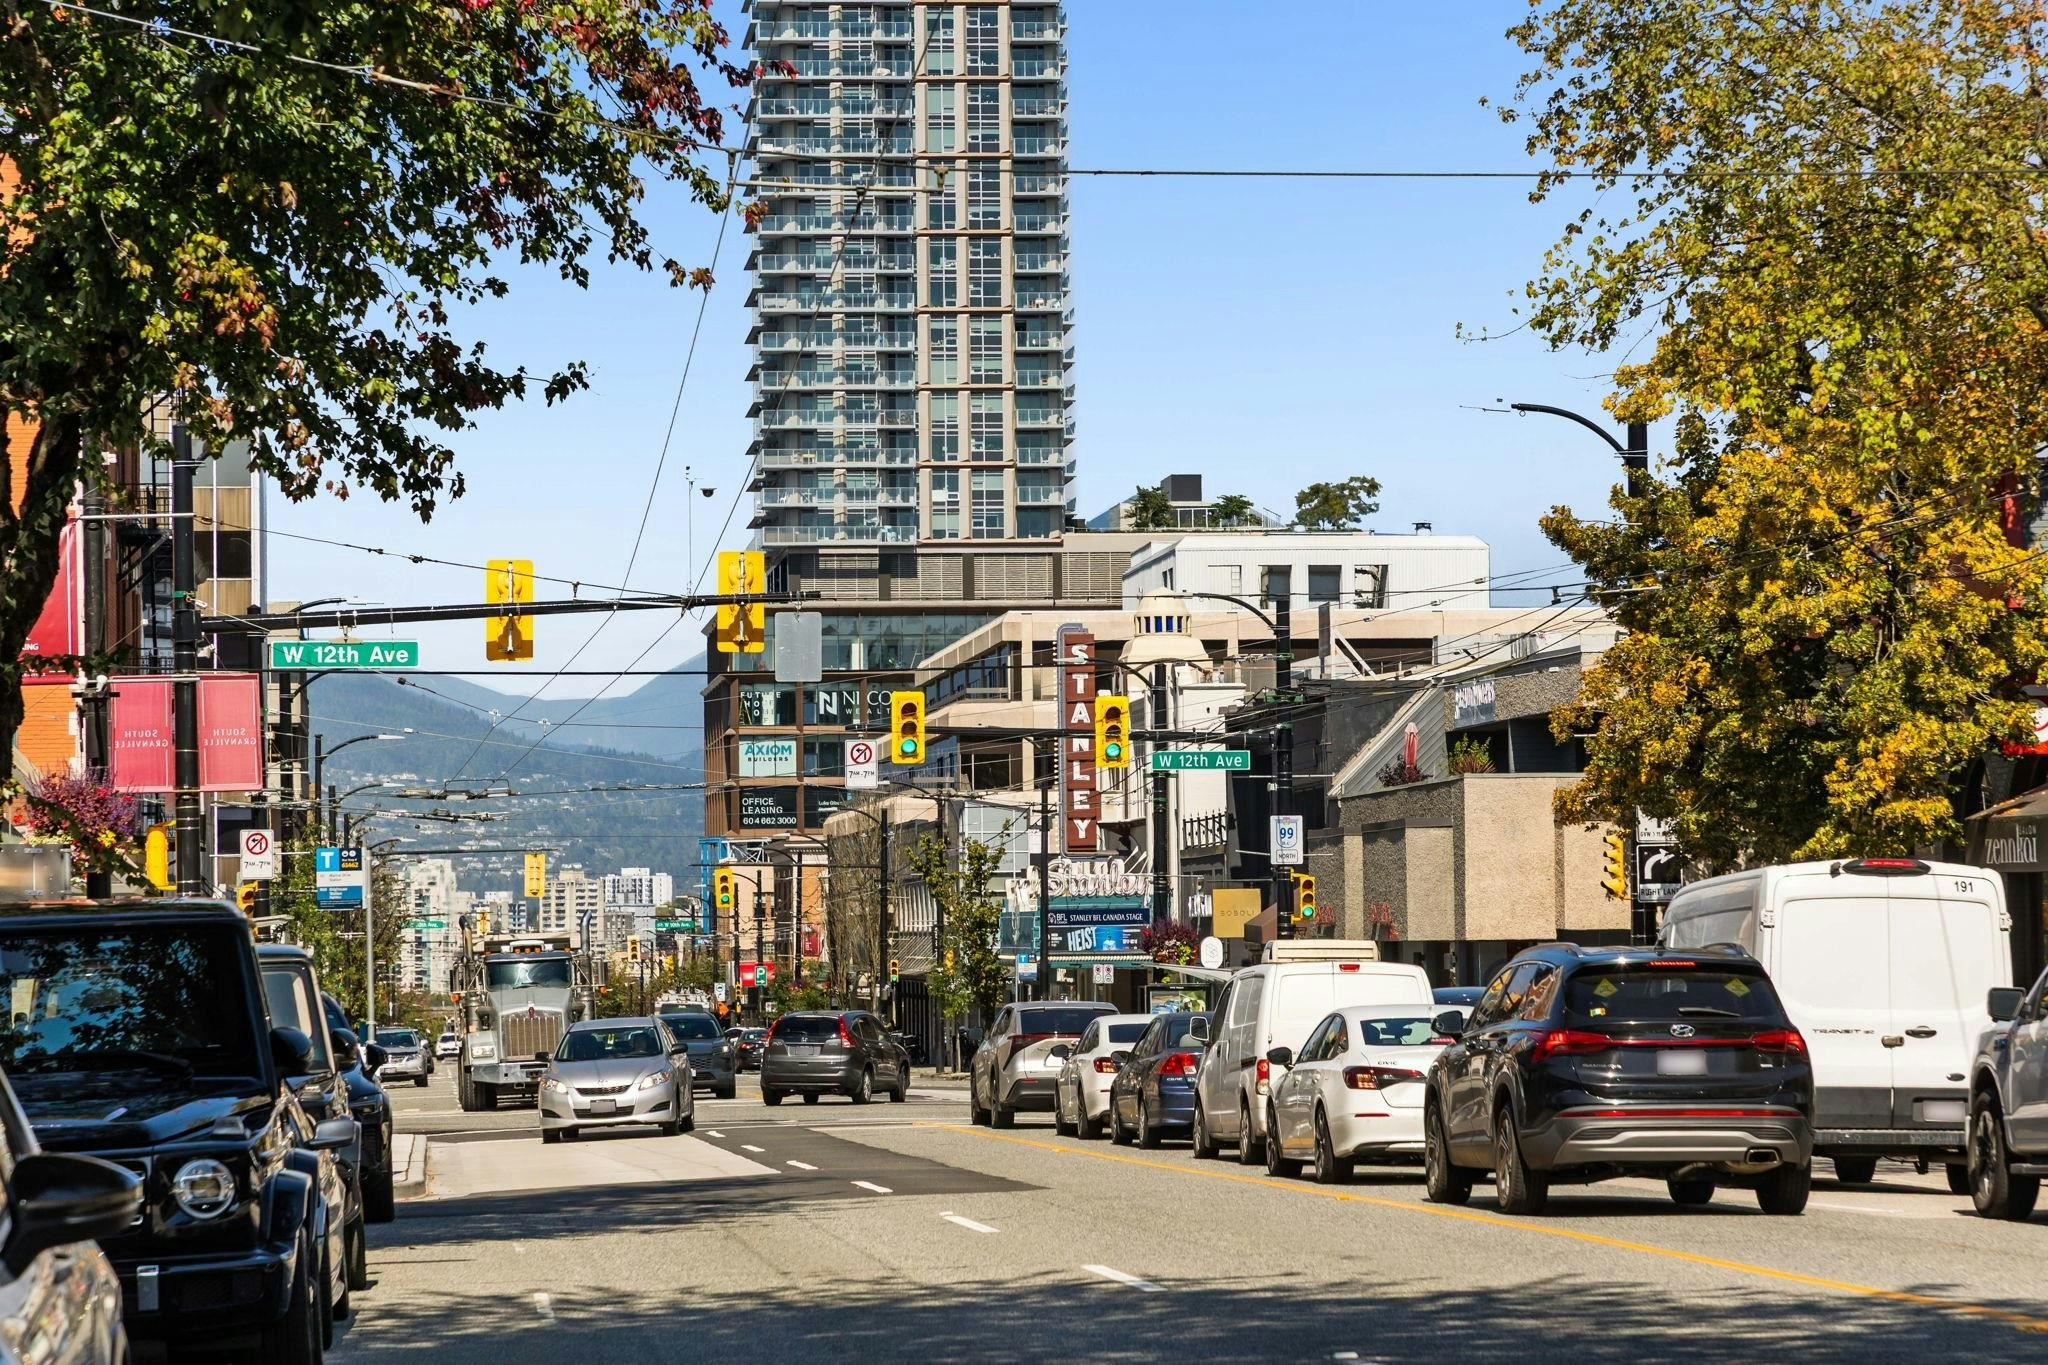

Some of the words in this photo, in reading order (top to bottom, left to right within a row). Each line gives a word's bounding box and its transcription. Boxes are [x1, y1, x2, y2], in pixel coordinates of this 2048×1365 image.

[283, 646, 304, 663] W
[314, 645, 359, 663] 12th
[369, 645, 409, 663] Ave
[843, 690, 893, 706] NICO
[845, 707, 893, 715] WEALT
[1070, 643, 1091, 838] STANLEY
[744, 744, 792, 755] AXIOM
[1159, 754, 1172, 767] W
[1179, 754, 1208, 767] 12th
[1215, 754, 1242, 767] Ave
[742, 797, 774, 806] OFFICE
[742, 806, 783, 815] LEASING
[743, 816, 760, 825] 604
[761, 816, 776, 825] 662
[777, 816, 797, 825] 3000
[1280, 827, 1293, 839] 99
[1640, 888, 1660, 896] RIGHT
[1954, 880, 1974, 893] 191
[1069, 914, 1092, 922] STANLEY
[1102, 913, 1126, 921] CANADA
[1126, 913, 1143, 921] STAGE
[1067, 926, 1097, 952] HEIST
[756, 968, 765, 979] P
